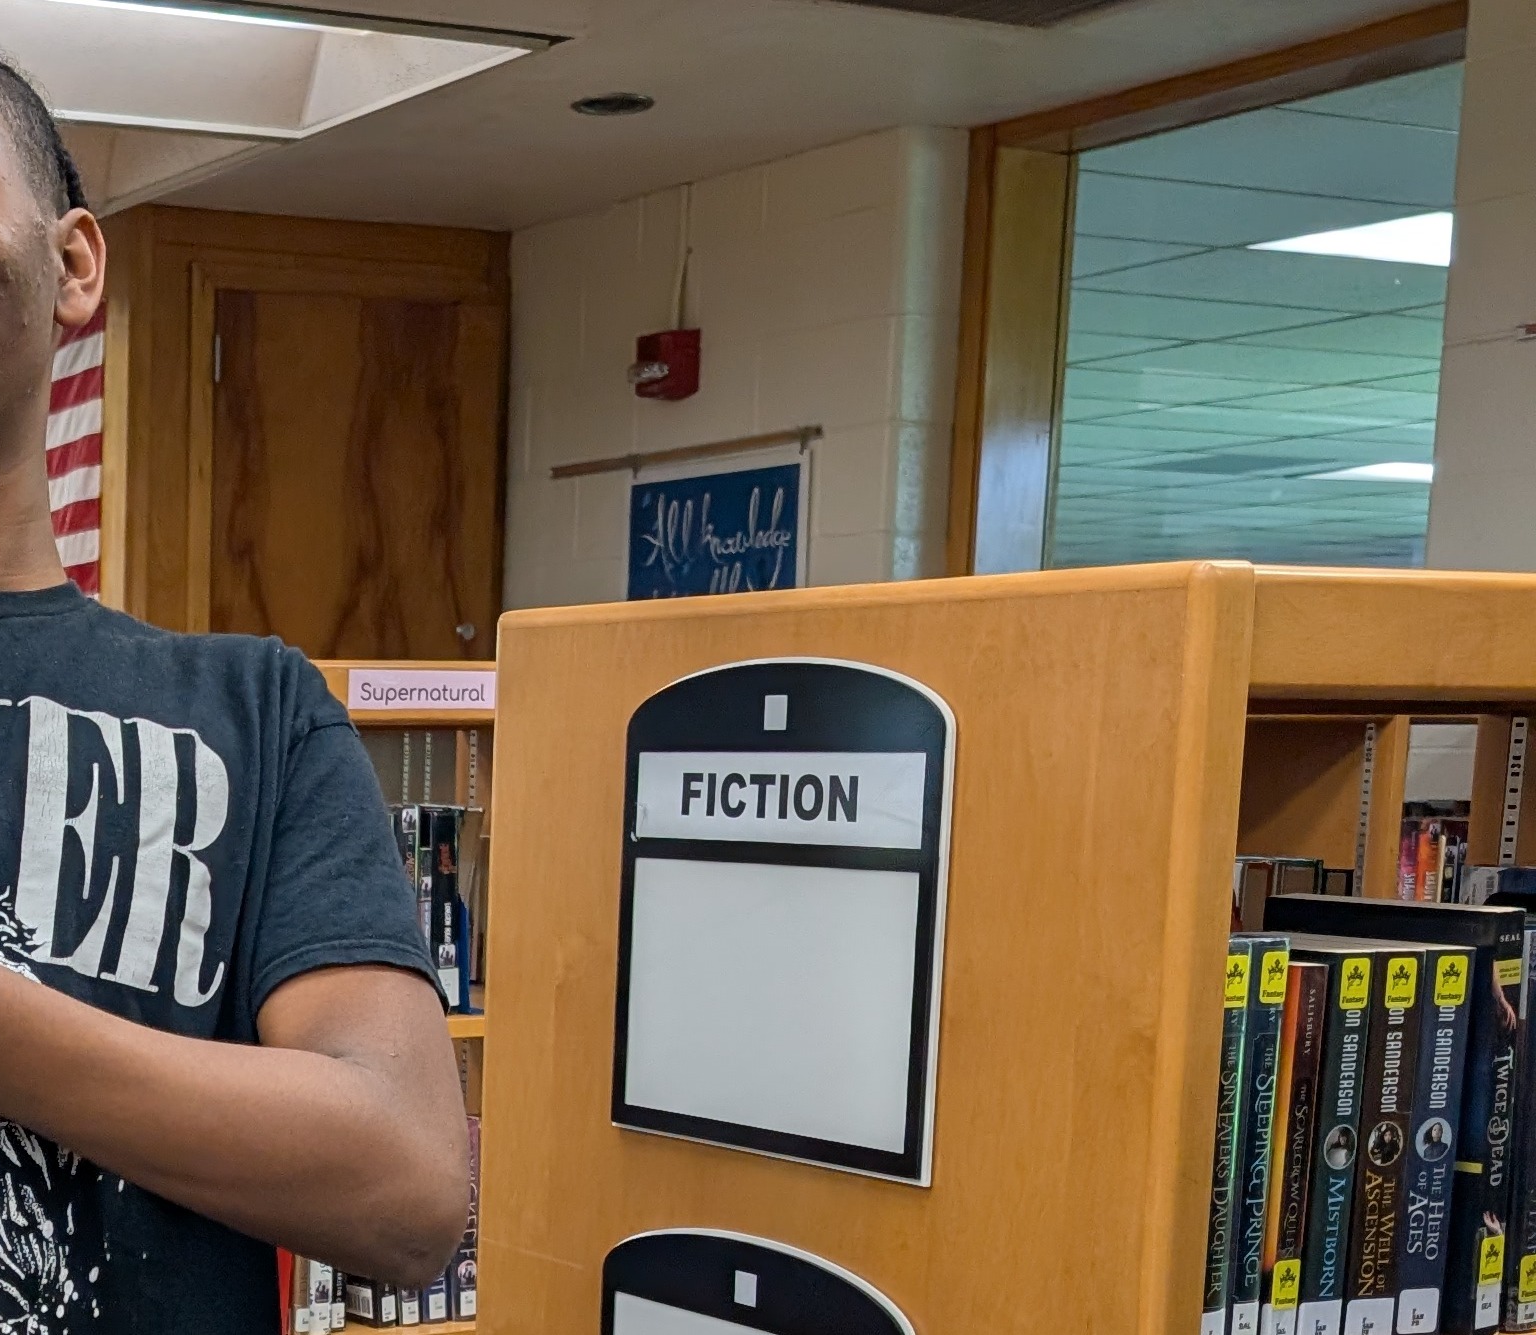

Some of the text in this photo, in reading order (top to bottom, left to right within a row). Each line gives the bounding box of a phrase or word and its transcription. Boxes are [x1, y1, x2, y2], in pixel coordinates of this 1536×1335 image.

[641, 492, 695, 570] All
[702, 486, 792, 590] knowledge
[360, 682, 486, 706] Supernatural
[681, 772, 860, 823] FICTION
[1499, 934, 1522, 943] SEAL
[1303, 988, 1317, 1056] SALISBURY
[1342, 996, 1366, 1004] Fantasy
[1387, 996, 1412, 1004] Fantasy
[1437, 993, 1463, 1001] Fantasy
[1219, 1071, 1239, 1110] SIN
[1227, 1045, 1237, 1068] THE
[1264, 1046, 1274, 1068] THE
[1336, 1034, 1359, 1116] SANDERSON
[1380, 1032, 1403, 1113] SANDERSON
[1429, 1028, 1453, 1109] SANDERSON
[1492, 1047, 1514, 1112] TWICE
[1248, 1073, 1274, 1192] SLEEPING
[1289, 1104, 1309, 1200] SCARECROW
[1206, 1186, 1230, 1298] DAUGHTER
[1244, 1196, 1268, 1288] PRINCE
[1318, 1177, 1346, 1297] MISTBORN
[1358, 1168, 1383, 1297] ASCENSION
[1375, 1178, 1396, 1291] THE WELL OF
[1406, 1171, 1428, 1254] OF AGES
[1425, 1163, 1446, 1260] THE HERO
